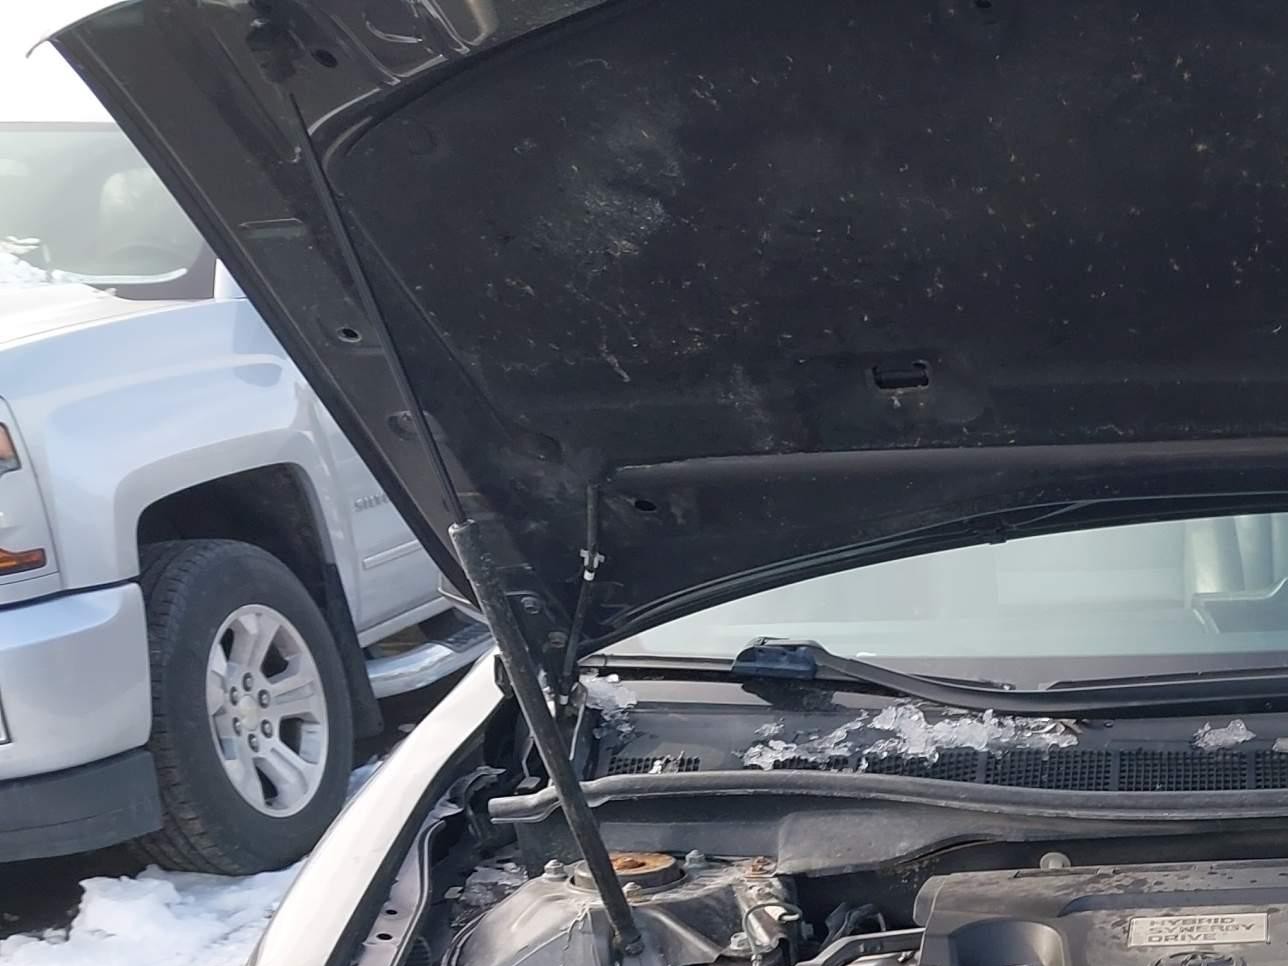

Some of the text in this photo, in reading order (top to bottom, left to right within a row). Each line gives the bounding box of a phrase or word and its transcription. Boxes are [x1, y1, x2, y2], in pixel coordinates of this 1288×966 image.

[1149, 917, 1235, 927] HYBRID
[1149, 924, 1255, 933] SYNERGY
[1147, 933, 1217, 942] DRIVE
